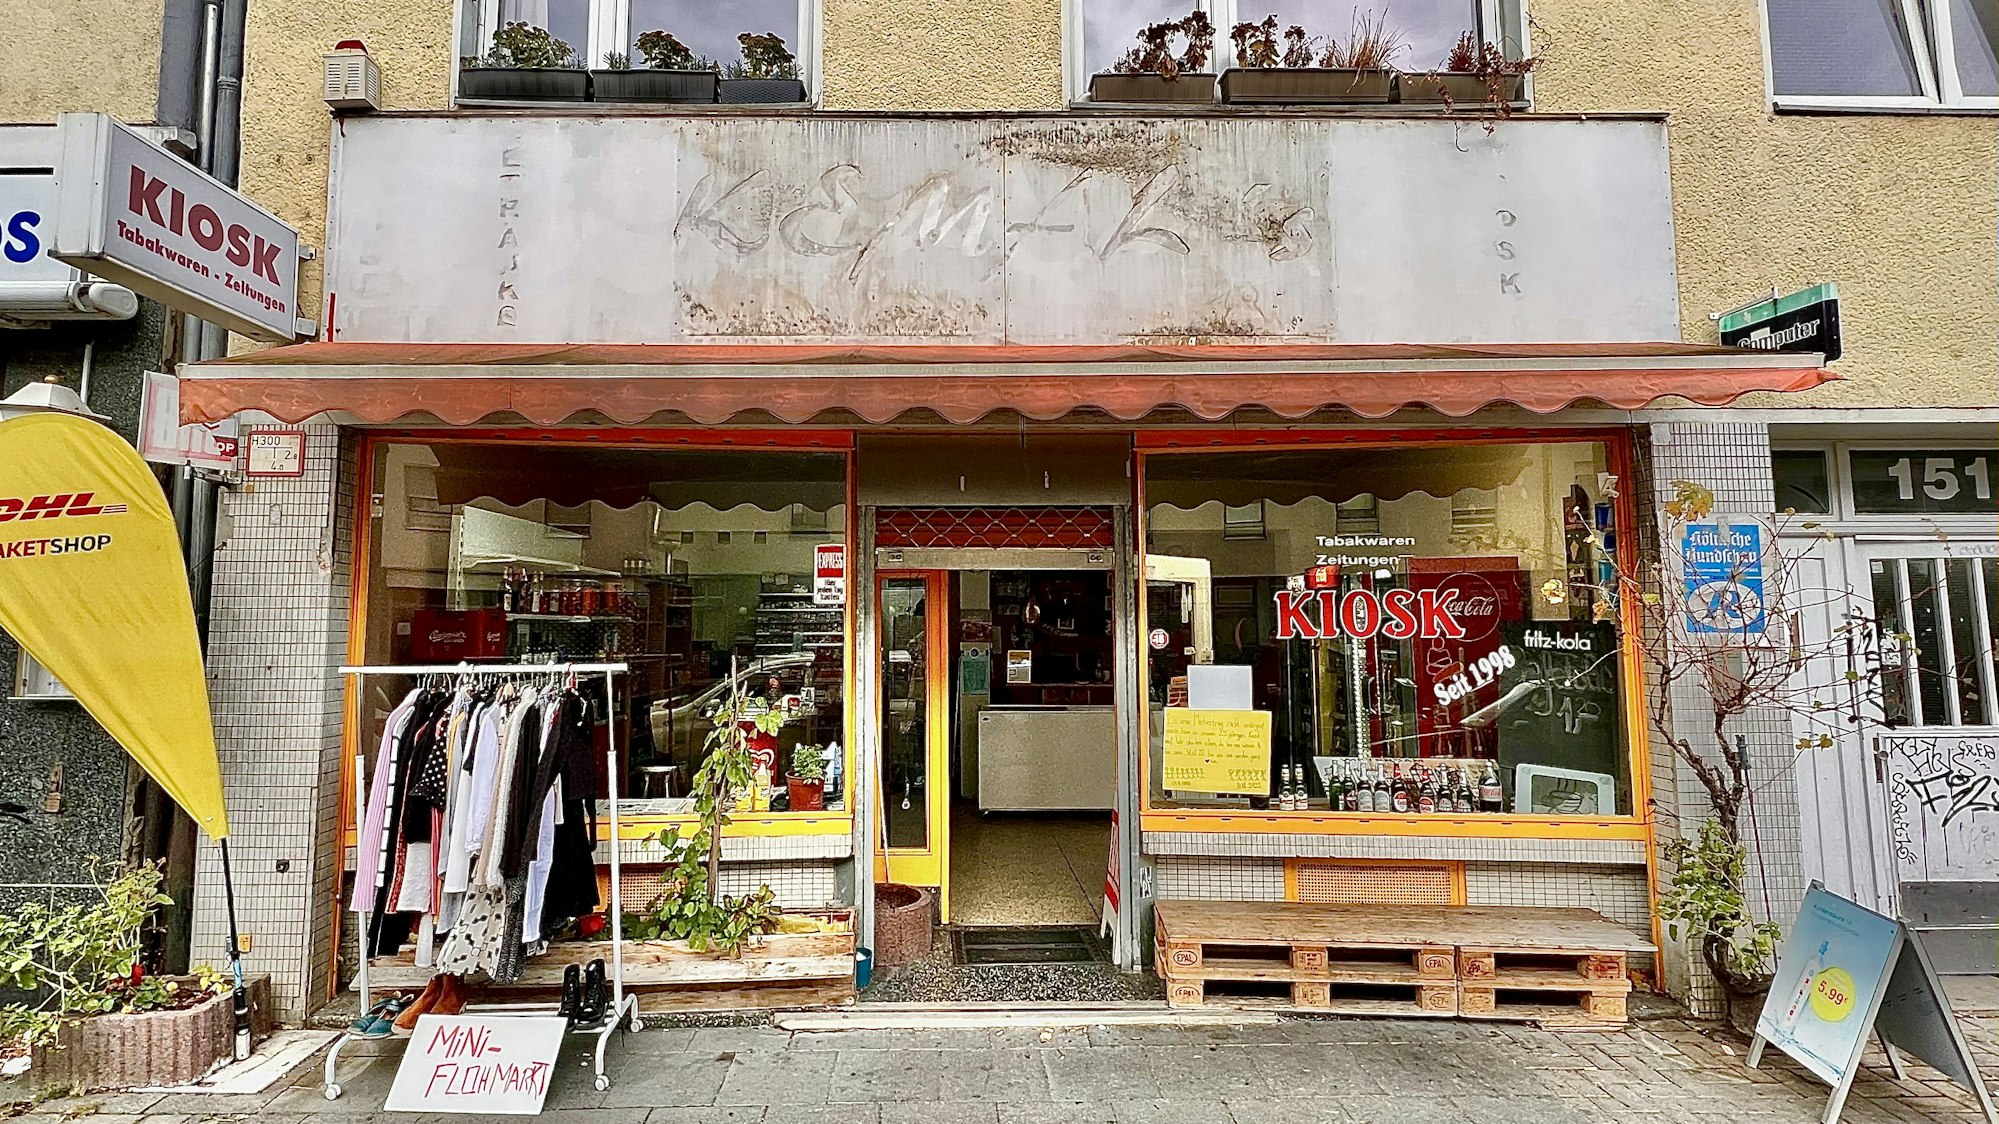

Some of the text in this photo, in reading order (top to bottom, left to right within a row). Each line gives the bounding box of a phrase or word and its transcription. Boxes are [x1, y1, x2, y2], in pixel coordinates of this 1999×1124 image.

[0, 210, 41, 263] S
[129, 164, 281, 287] KIOSK
[117, 219, 209, 278] Tabakwaren
[224, 272, 286, 314] Zeitungen
[252, 436, 281, 446] H300
[1889, 457, 1991, 499] 151
[1315, 535, 1416, 547] Tabakwaren
[1315, 554, 1399, 568] Zeitungen
[1274, 588, 1467, 640] KIOSK
[1523, 629, 1591, 651] fritz-kola
[1433, 673, 1473, 706] Seit
[1468, 645, 1516, 688] 1998
